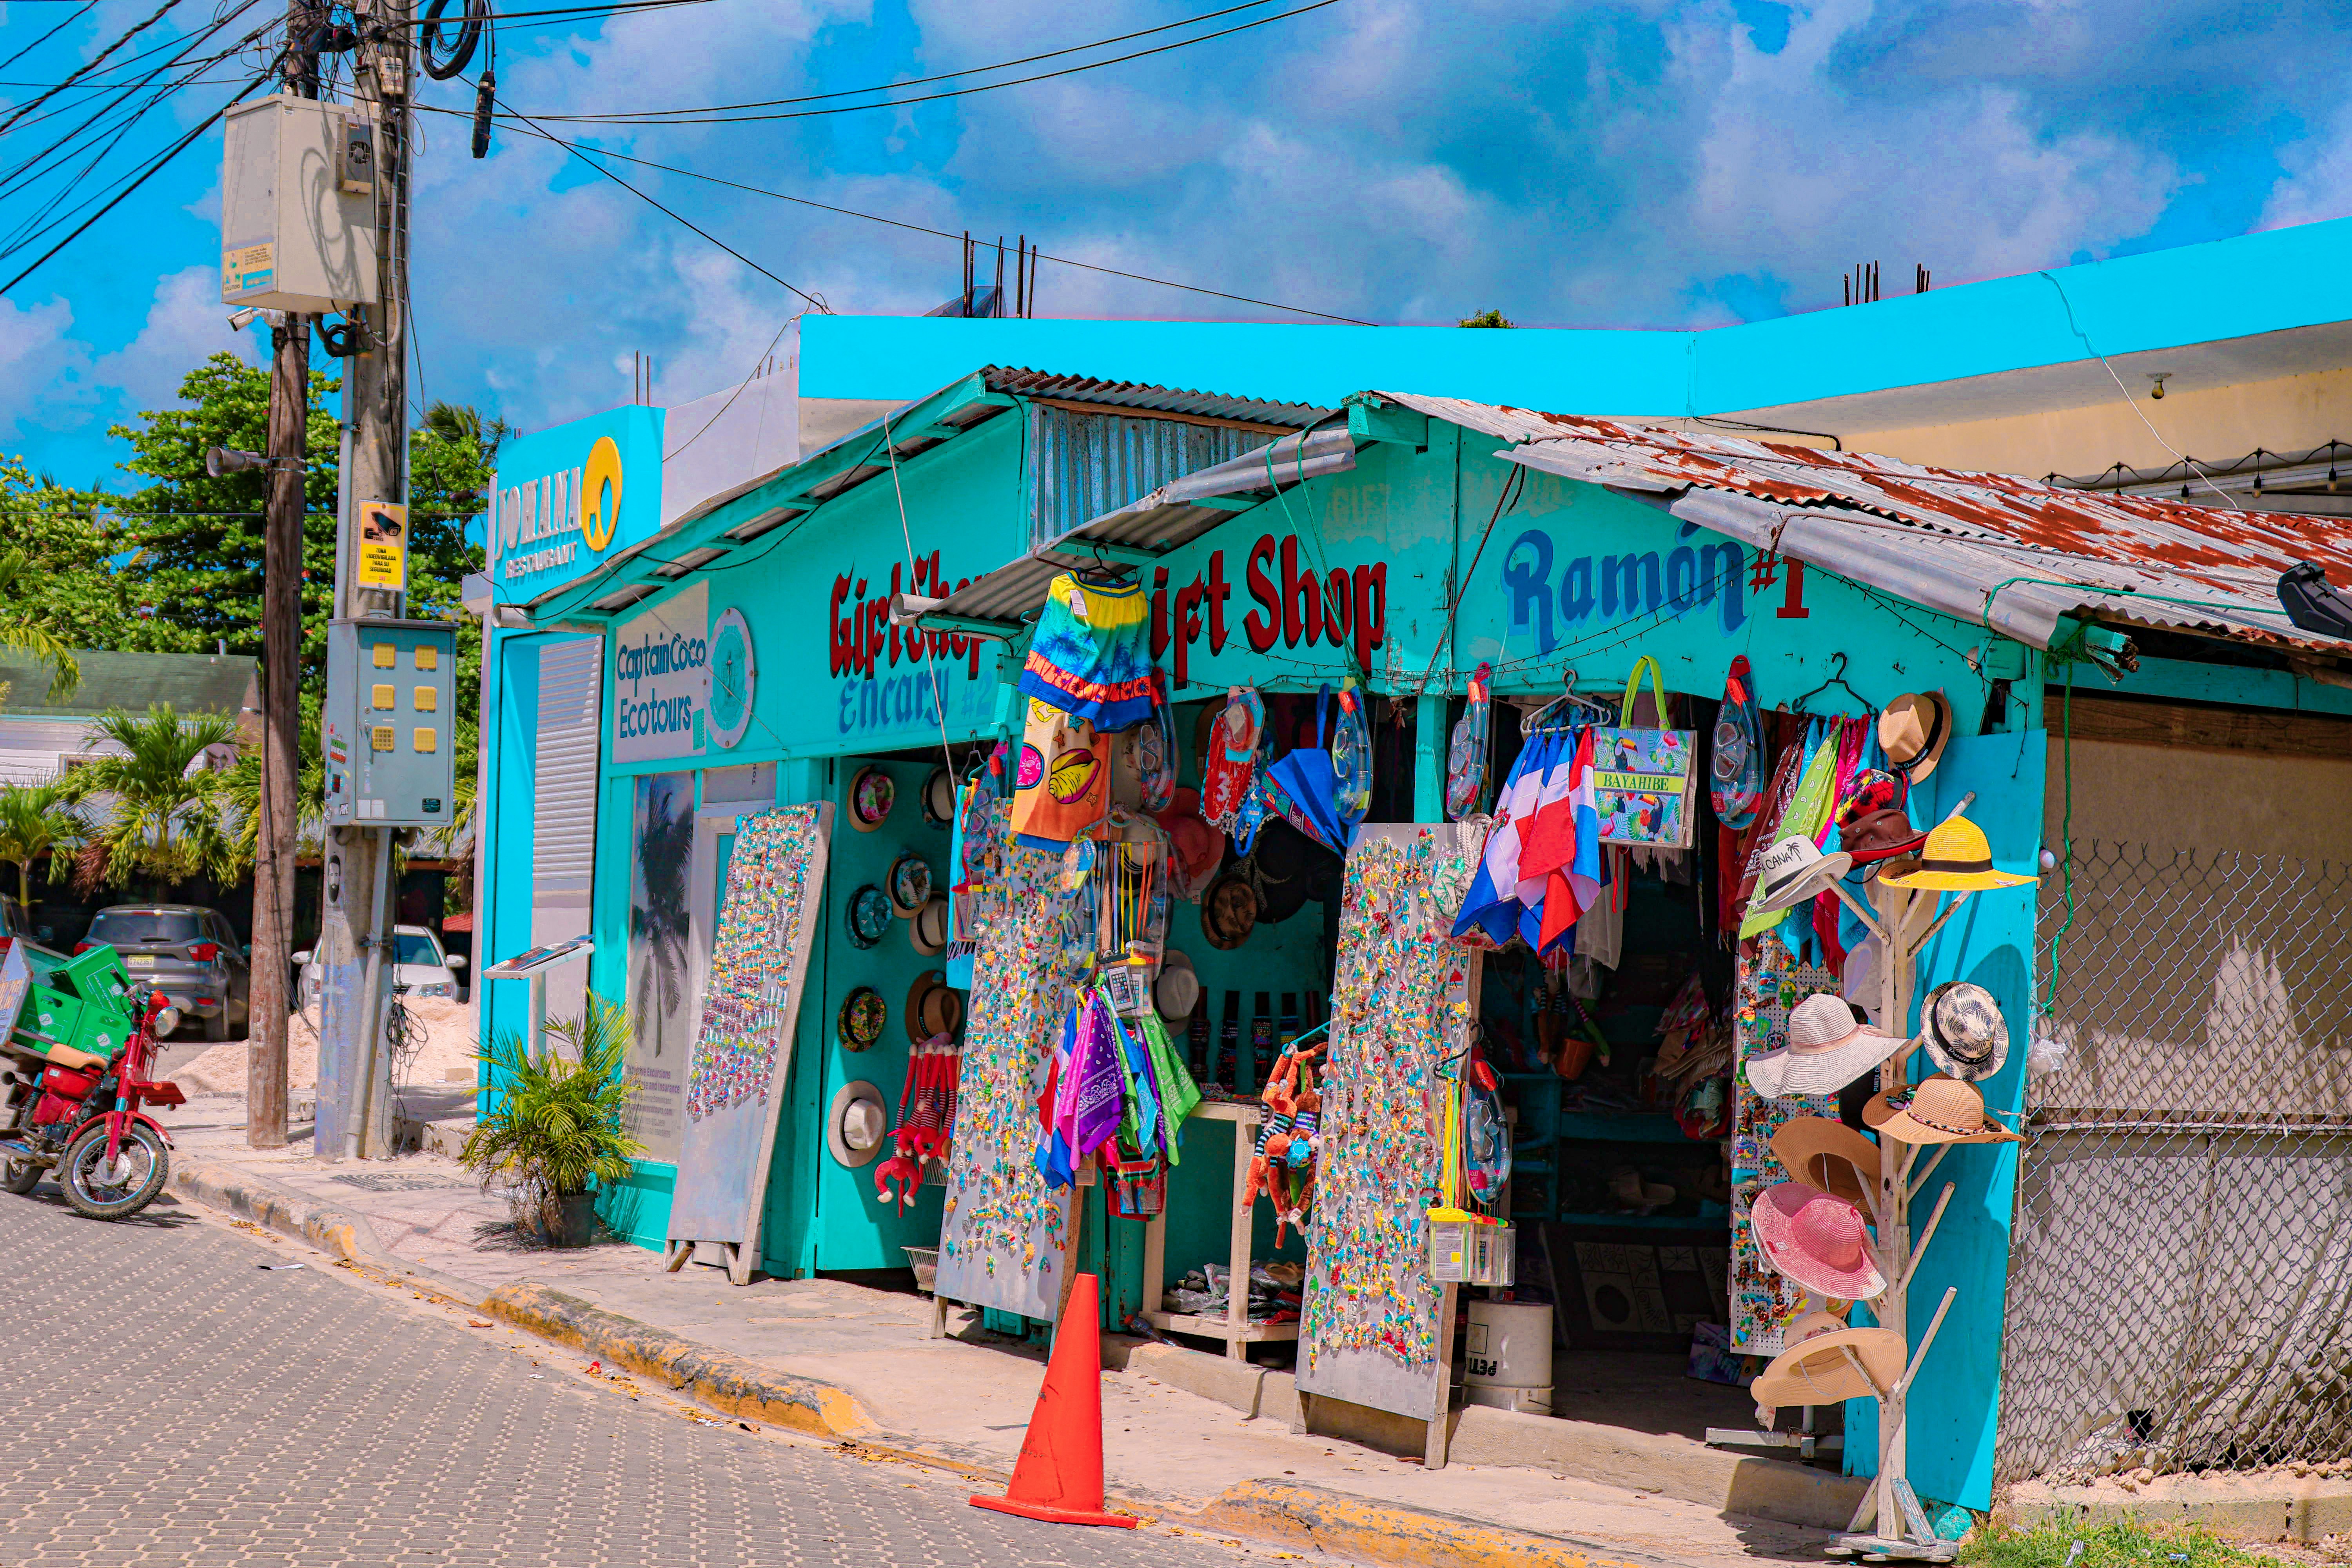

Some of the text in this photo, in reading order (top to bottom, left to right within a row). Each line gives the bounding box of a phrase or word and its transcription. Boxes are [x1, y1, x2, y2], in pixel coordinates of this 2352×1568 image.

[495, 466, 583, 560] JOHANA
[505, 541, 577, 579] RESTAURANT
[1501, 519, 1809, 662] Ramón #1
[1243, 533, 1388, 681] Shop
[619, 688, 691, 739] Ecotours
[1603, 773, 1669, 791] BAYAHIBE
[1083, 842, 1092, 857] AQUA
[1765, 852, 1793, 869] CANA
[84, 1044, 111, 1060] Presiden
[1947, 1046, 1970, 1062] Punta
[647, 1067, 671, 1079] Excursions
[658, 1081, 681, 1094] Insurance
